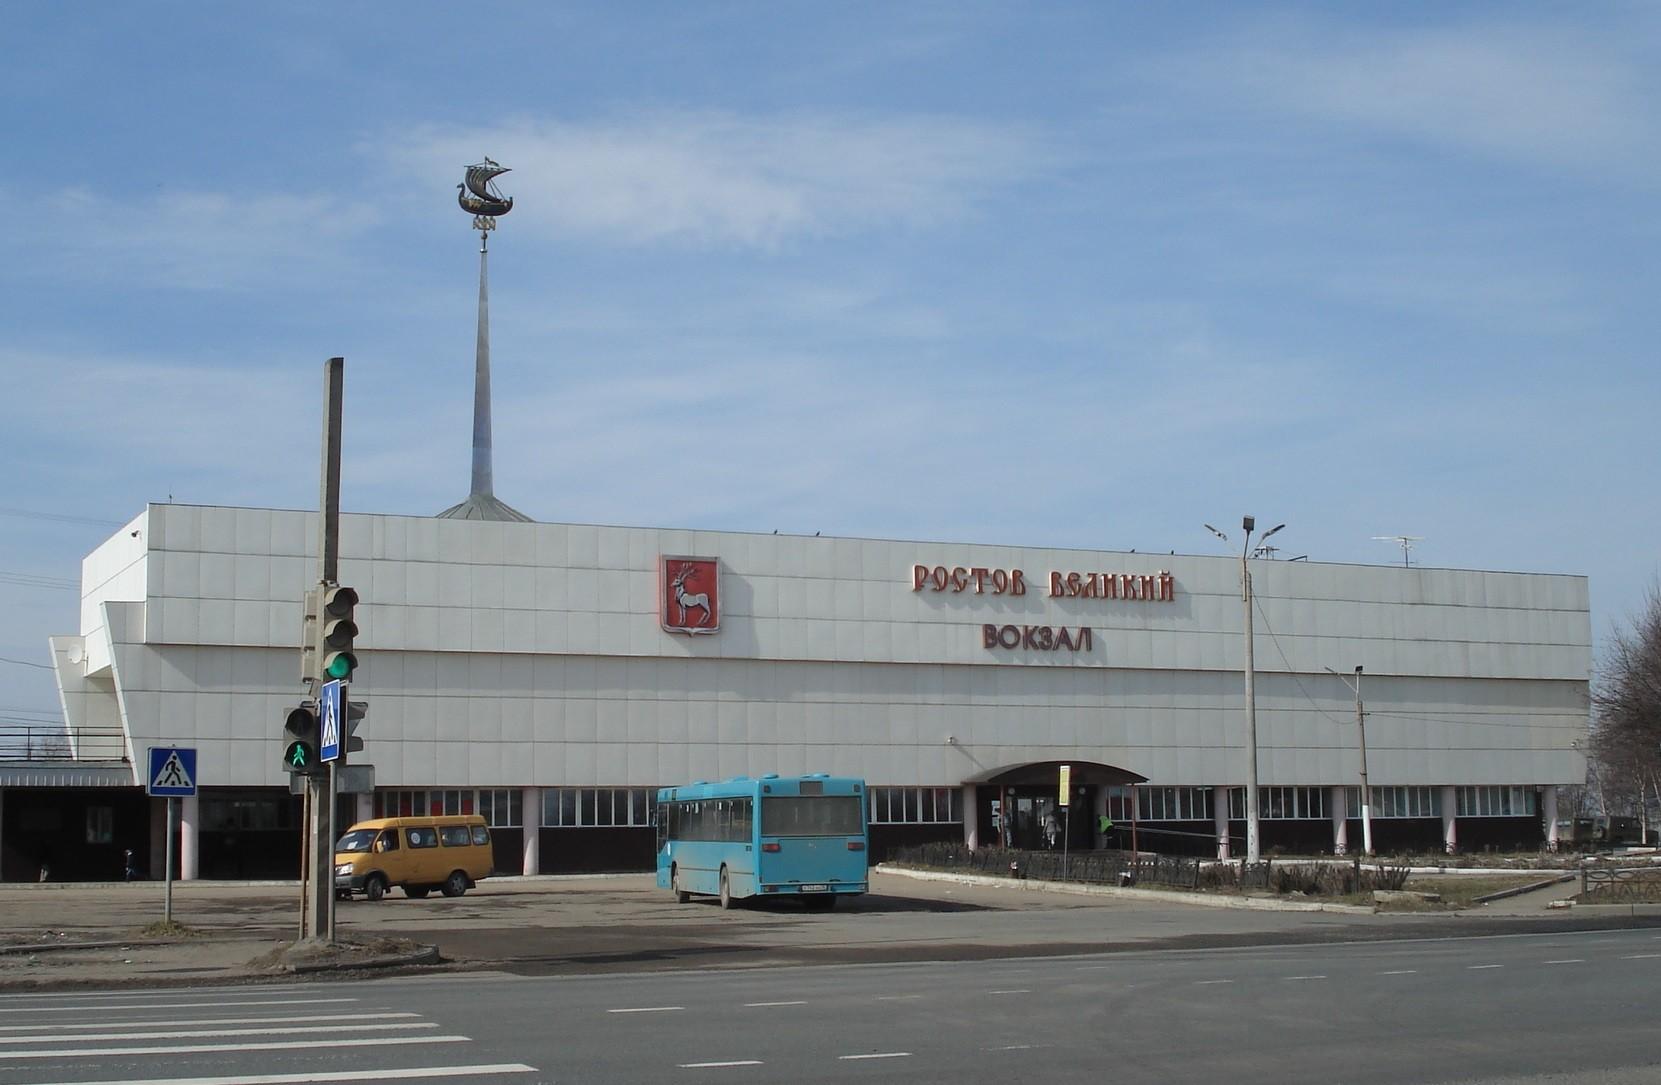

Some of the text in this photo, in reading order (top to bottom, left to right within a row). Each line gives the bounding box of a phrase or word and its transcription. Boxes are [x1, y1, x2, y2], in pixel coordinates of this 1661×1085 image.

[912, 564, 1175, 602] РОСТОВ ВЕЛИКИЙ
[983, 623, 1092, 651] ВОКЗАЛ
